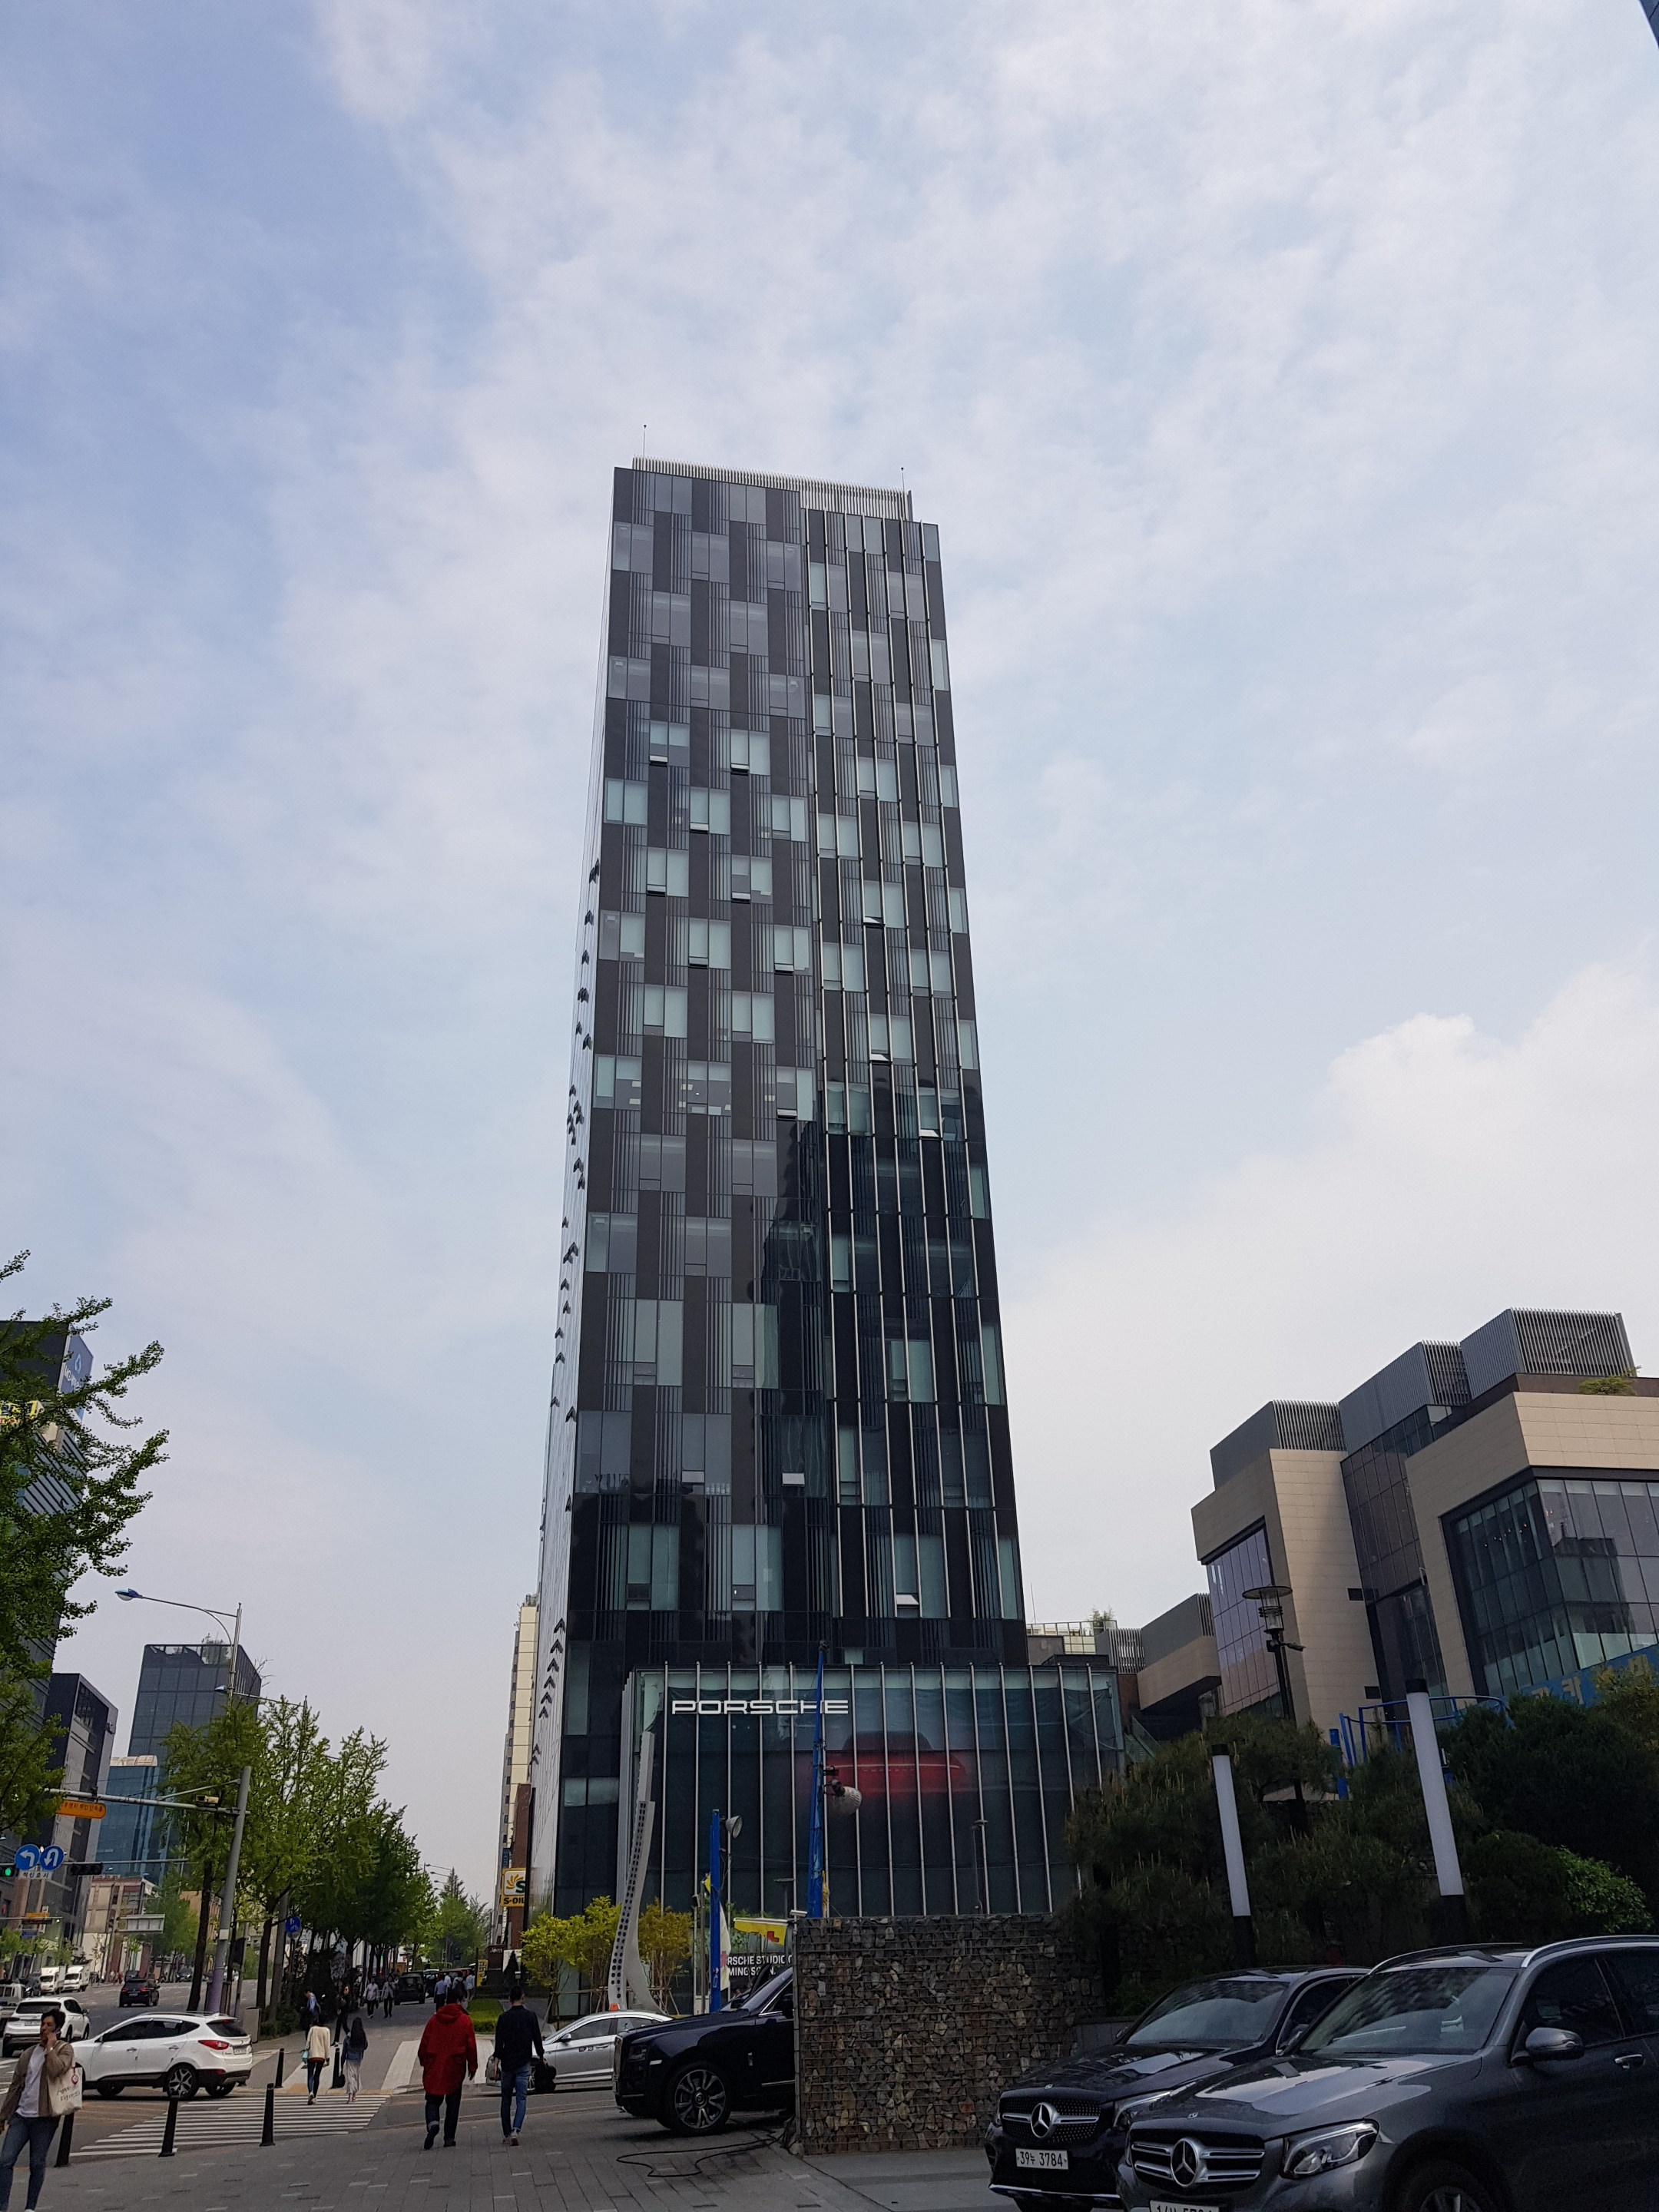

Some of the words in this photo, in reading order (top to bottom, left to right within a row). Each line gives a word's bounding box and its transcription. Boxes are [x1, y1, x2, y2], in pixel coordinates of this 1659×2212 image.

[671, 1700, 849, 1715] PORSCHE
[726, 1956, 755, 1965] RSCHE
[729, 1967, 750, 1976] MING
[1019, 2151, 1036, 2165] 39누
[1039, 2152, 1064, 2167] 3784
